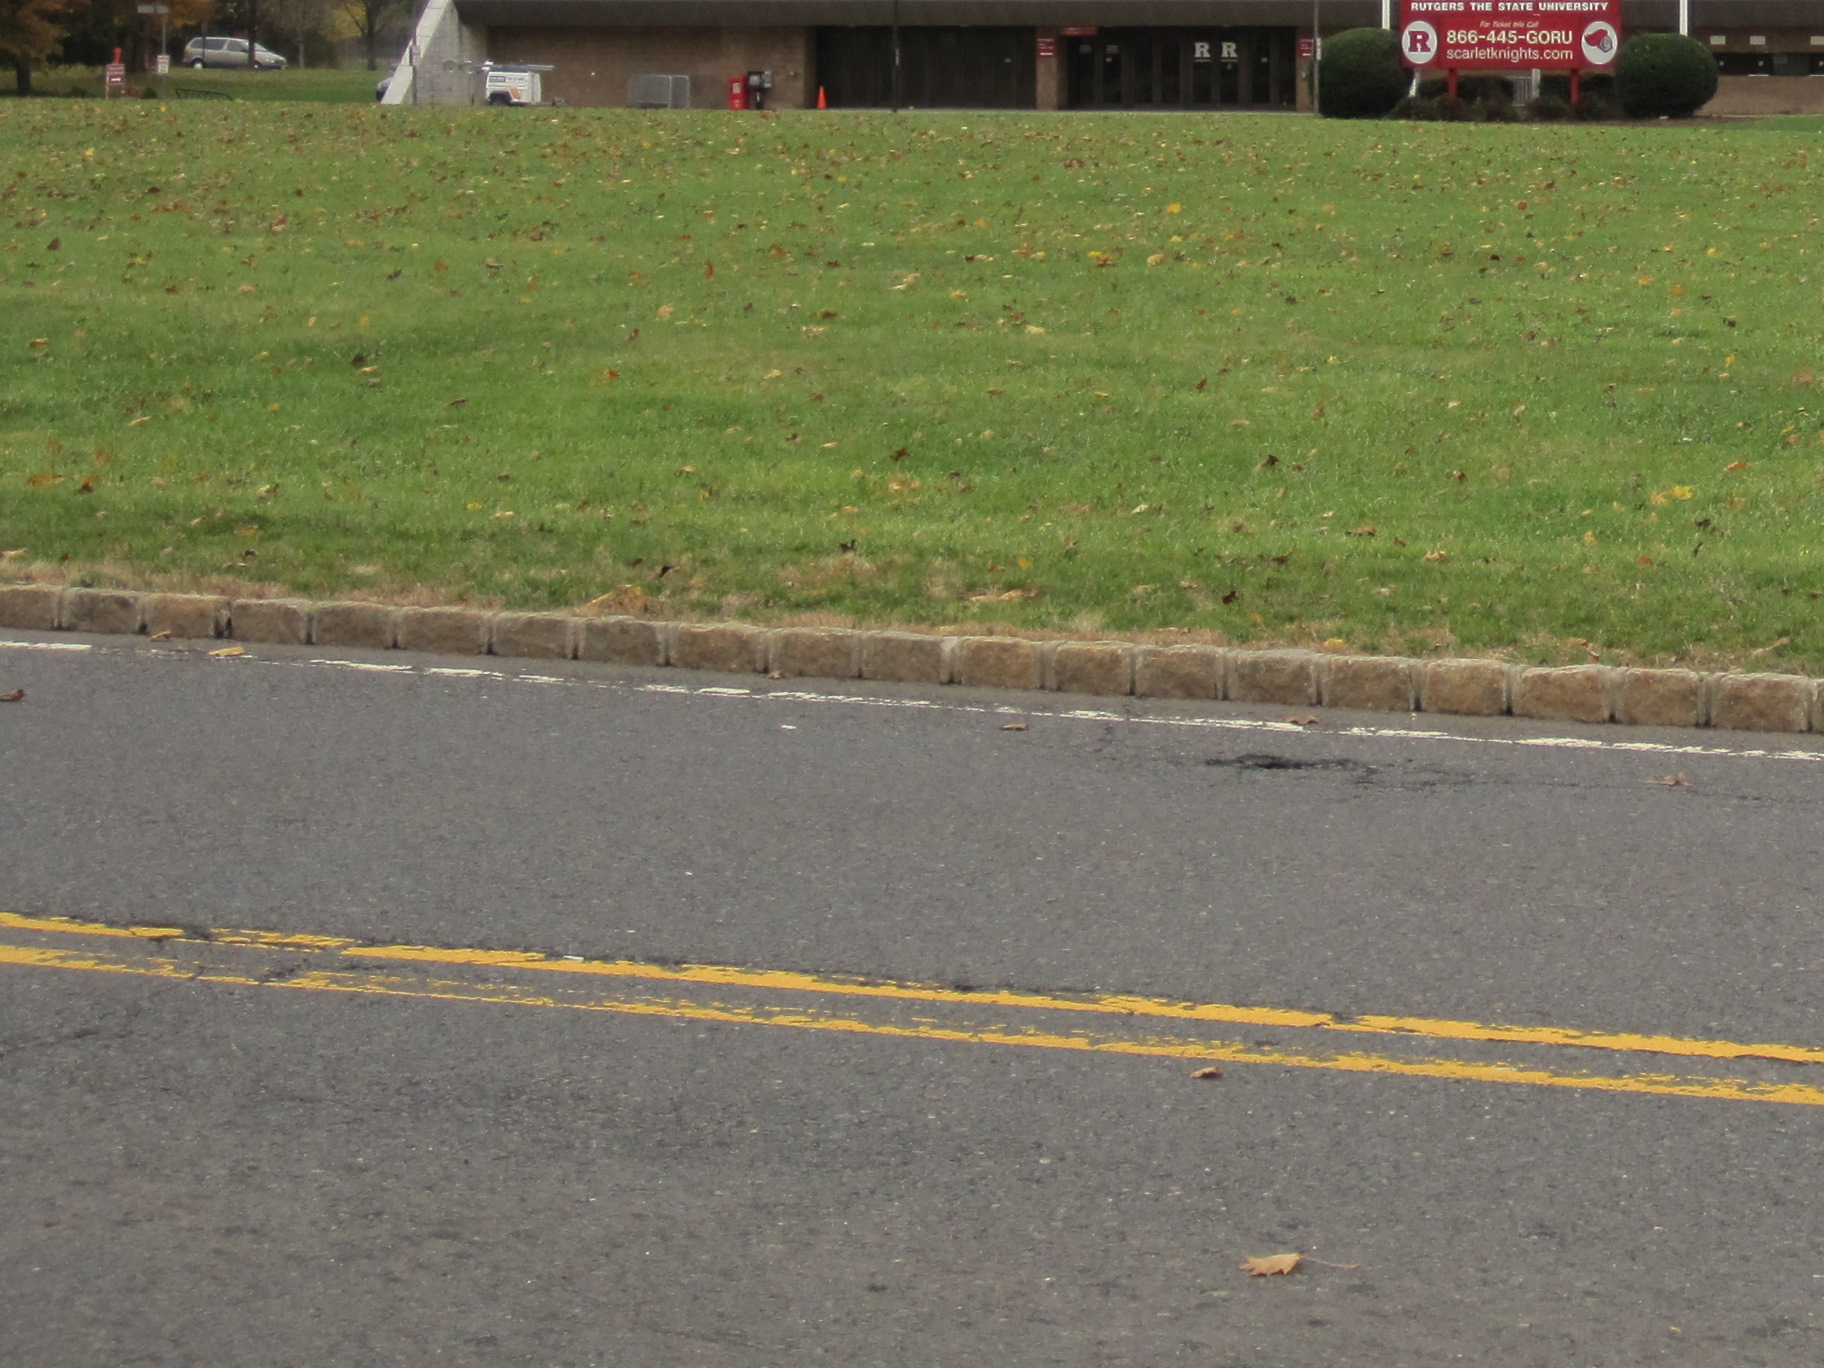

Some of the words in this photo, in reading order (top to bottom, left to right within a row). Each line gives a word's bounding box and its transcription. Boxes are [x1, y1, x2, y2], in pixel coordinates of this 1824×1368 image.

[1411, 2, 1465, 11] RUTGERS
[1470, 2, 1492, 11] THE
[1498, 2, 1533, 11] STATE
[1538, 2, 1608, 11] UNIVERSITY
[1408, 30, 1431, 52] R
[1446, 30, 1573, 44] 866-445-GORU
[1194, 42, 1211, 58] R
[1221, 42, 1238, 58] R
[1446, 46, 1573, 63] scarletknights.com
